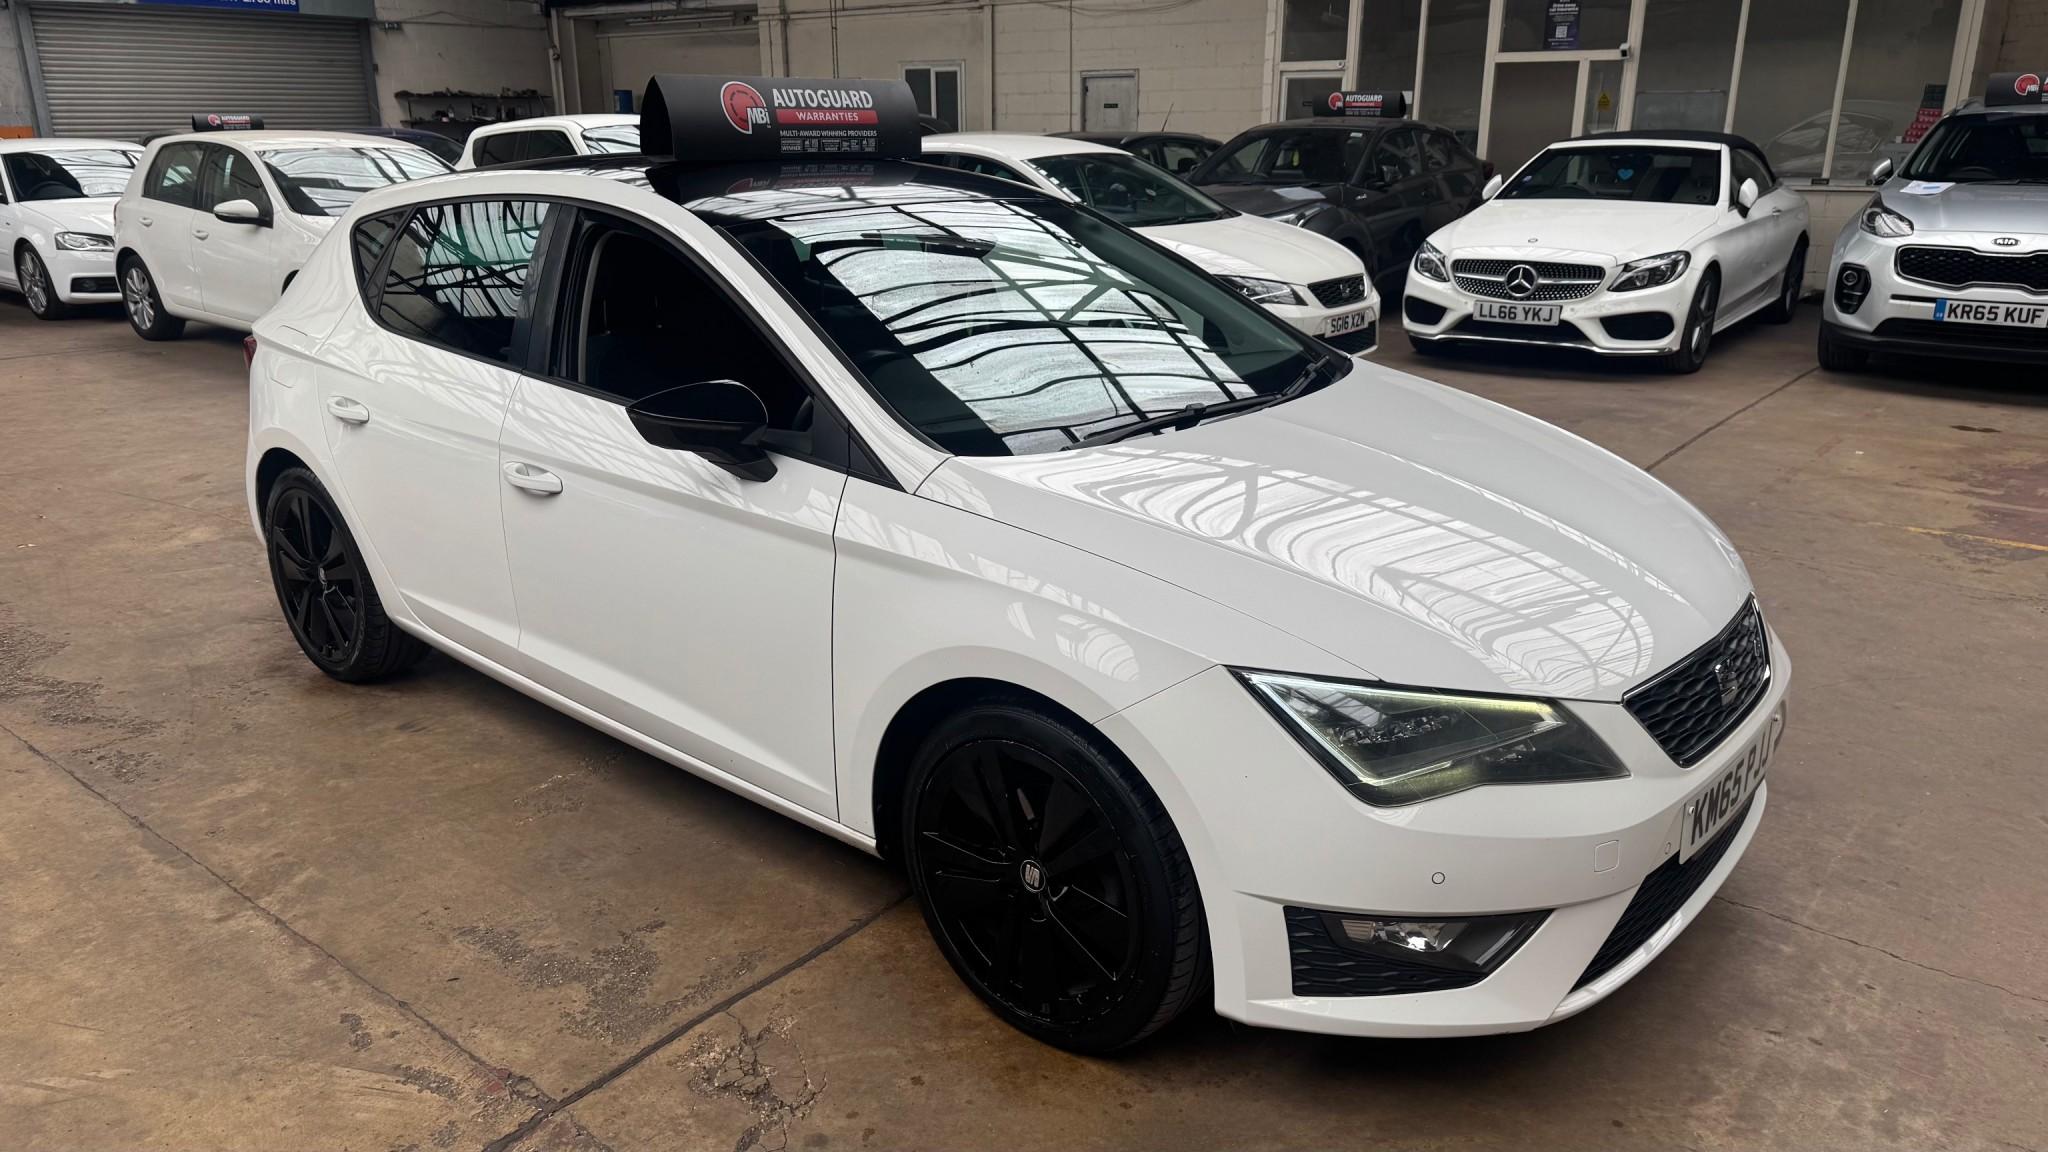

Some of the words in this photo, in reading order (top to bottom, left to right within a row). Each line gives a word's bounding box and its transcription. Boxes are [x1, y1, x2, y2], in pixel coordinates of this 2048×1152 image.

[772, 88, 873, 108] AUTOGUARD
[1345, 94, 1382, 102] AUTOGUARD
[747, 107, 771, 125] MBi
[796, 111, 859, 121] WARRANTIES
[1480, 304, 1517, 320] LL66
[1522, 307, 1553, 322] YKJ
[1947, 303, 2000, 321] KR65
[2003, 307, 2045, 324] KUF
[1331, 316, 1349, 333] SG16
[1691, 758, 1745, 846] KM65
[1744, 722, 1773, 793] PJJ
